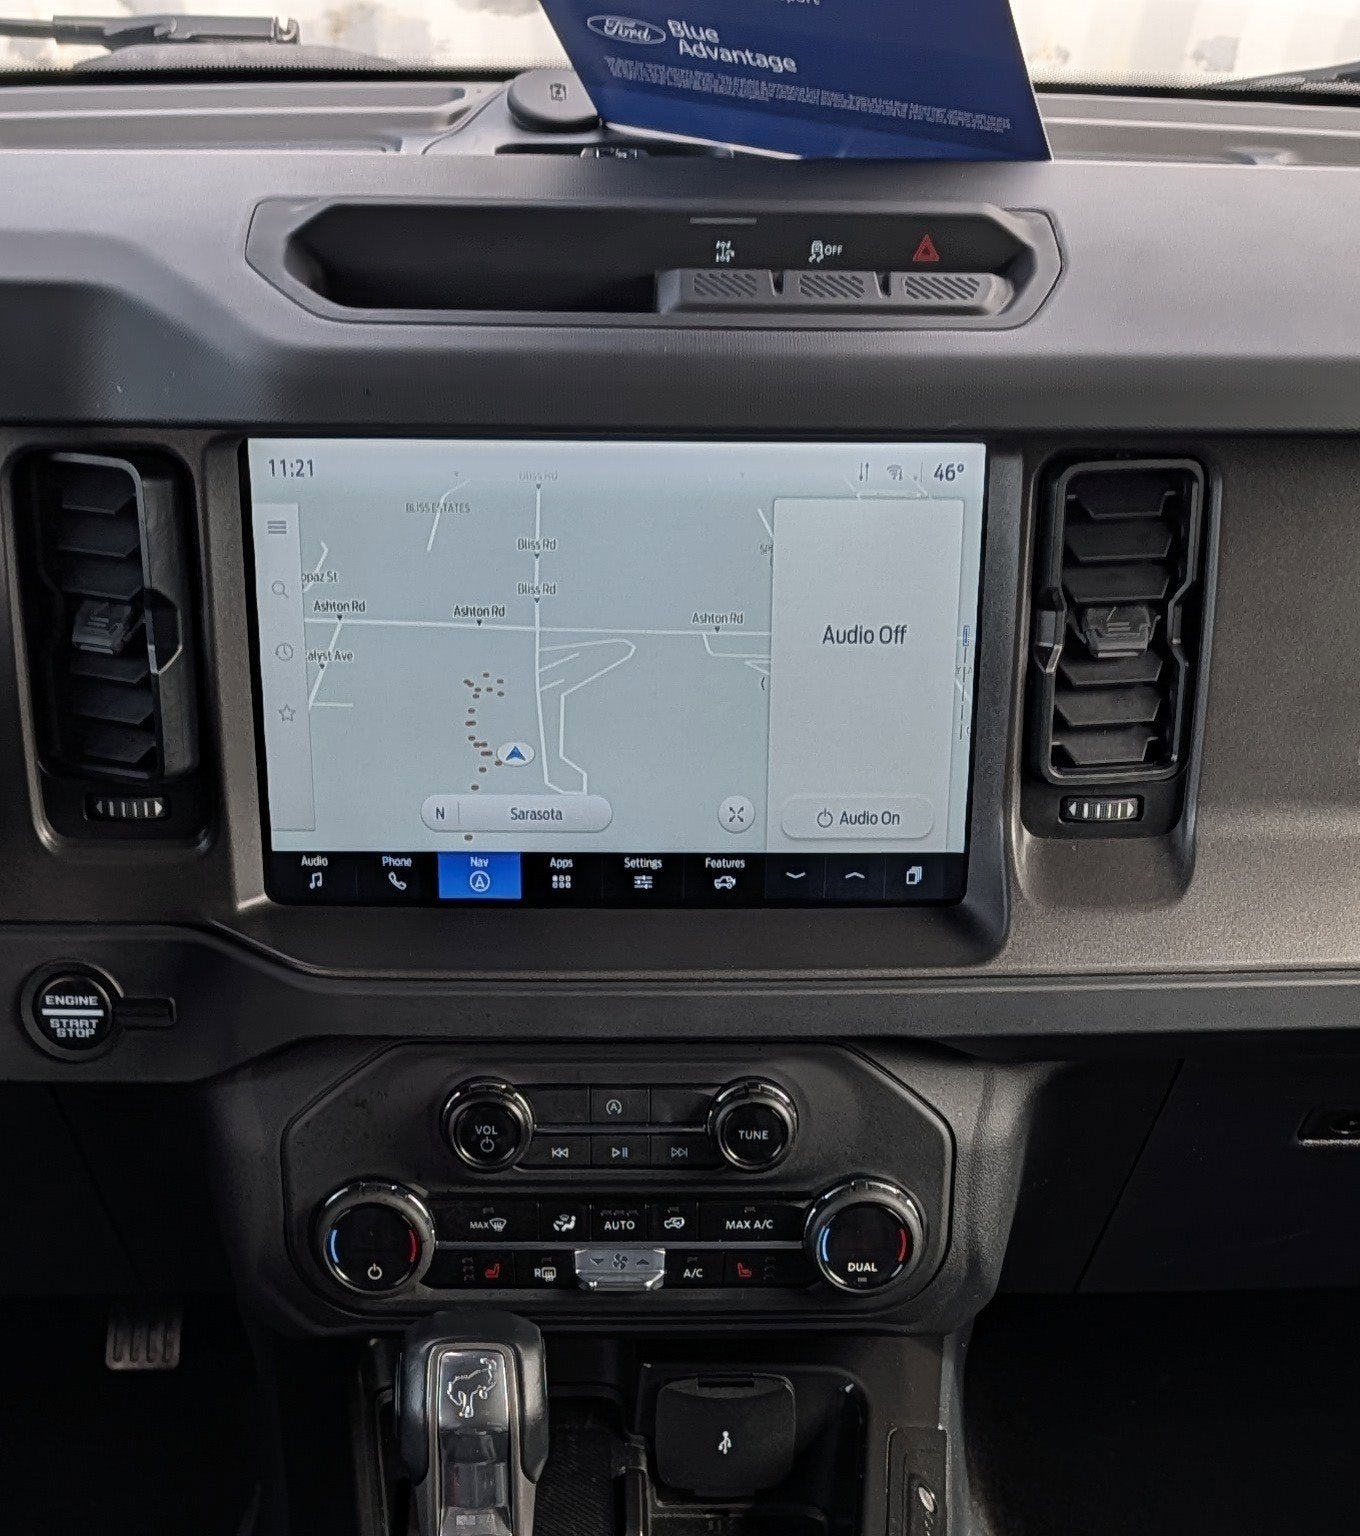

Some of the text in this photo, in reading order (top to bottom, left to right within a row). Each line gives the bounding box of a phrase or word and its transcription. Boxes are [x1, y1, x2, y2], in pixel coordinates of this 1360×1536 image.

[603, 18, 652, 42] Ford
[667, 19, 720, 43] Blue
[679, 38, 798, 73] Advantage
[824, 244, 843, 256] OFF
[268, 459, 314, 477] 11:21
[517, 538, 557, 550] Bliss Rd
[301, 571, 339, 585] opaz St
[517, 583, 556, 595] Bliss Rd
[313, 600, 366, 612] Ashton Rd
[453, 605, 506, 617] Ashton Rd
[692, 612, 744, 624] Ashton Rd
[822, 624, 908, 645] Audio Off
[305, 651, 353, 664] alyst Ave
[435, 808, 445, 820] N
[510, 807, 563, 821] Sarasota
[839, 810, 900, 825] Audio On
[301, 855, 329, 866] Audio
[382, 855, 412, 867] Phone
[470, 856, 489, 867] Nav
[550, 857, 573, 869] Apps
[624, 857, 662, 870] Settings
[705, 857, 746, 868] Features
[45, 995, 98, 1006] ENGINE
[50, 1019, 99, 1028] START
[56, 1028, 95, 1038] STOP
[475, 1125, 498, 1135] VOL
[738, 1130, 769, 1140] TUNE
[470, 1221, 490, 1230] MAX
[604, 1221, 636, 1230] AUTO
[725, 1219, 773, 1230] MAX A/C
[534, 1269, 541, 1278] R
[683, 1268, 703, 1279] A/C
[847, 1262, 878, 1273] DUAL
